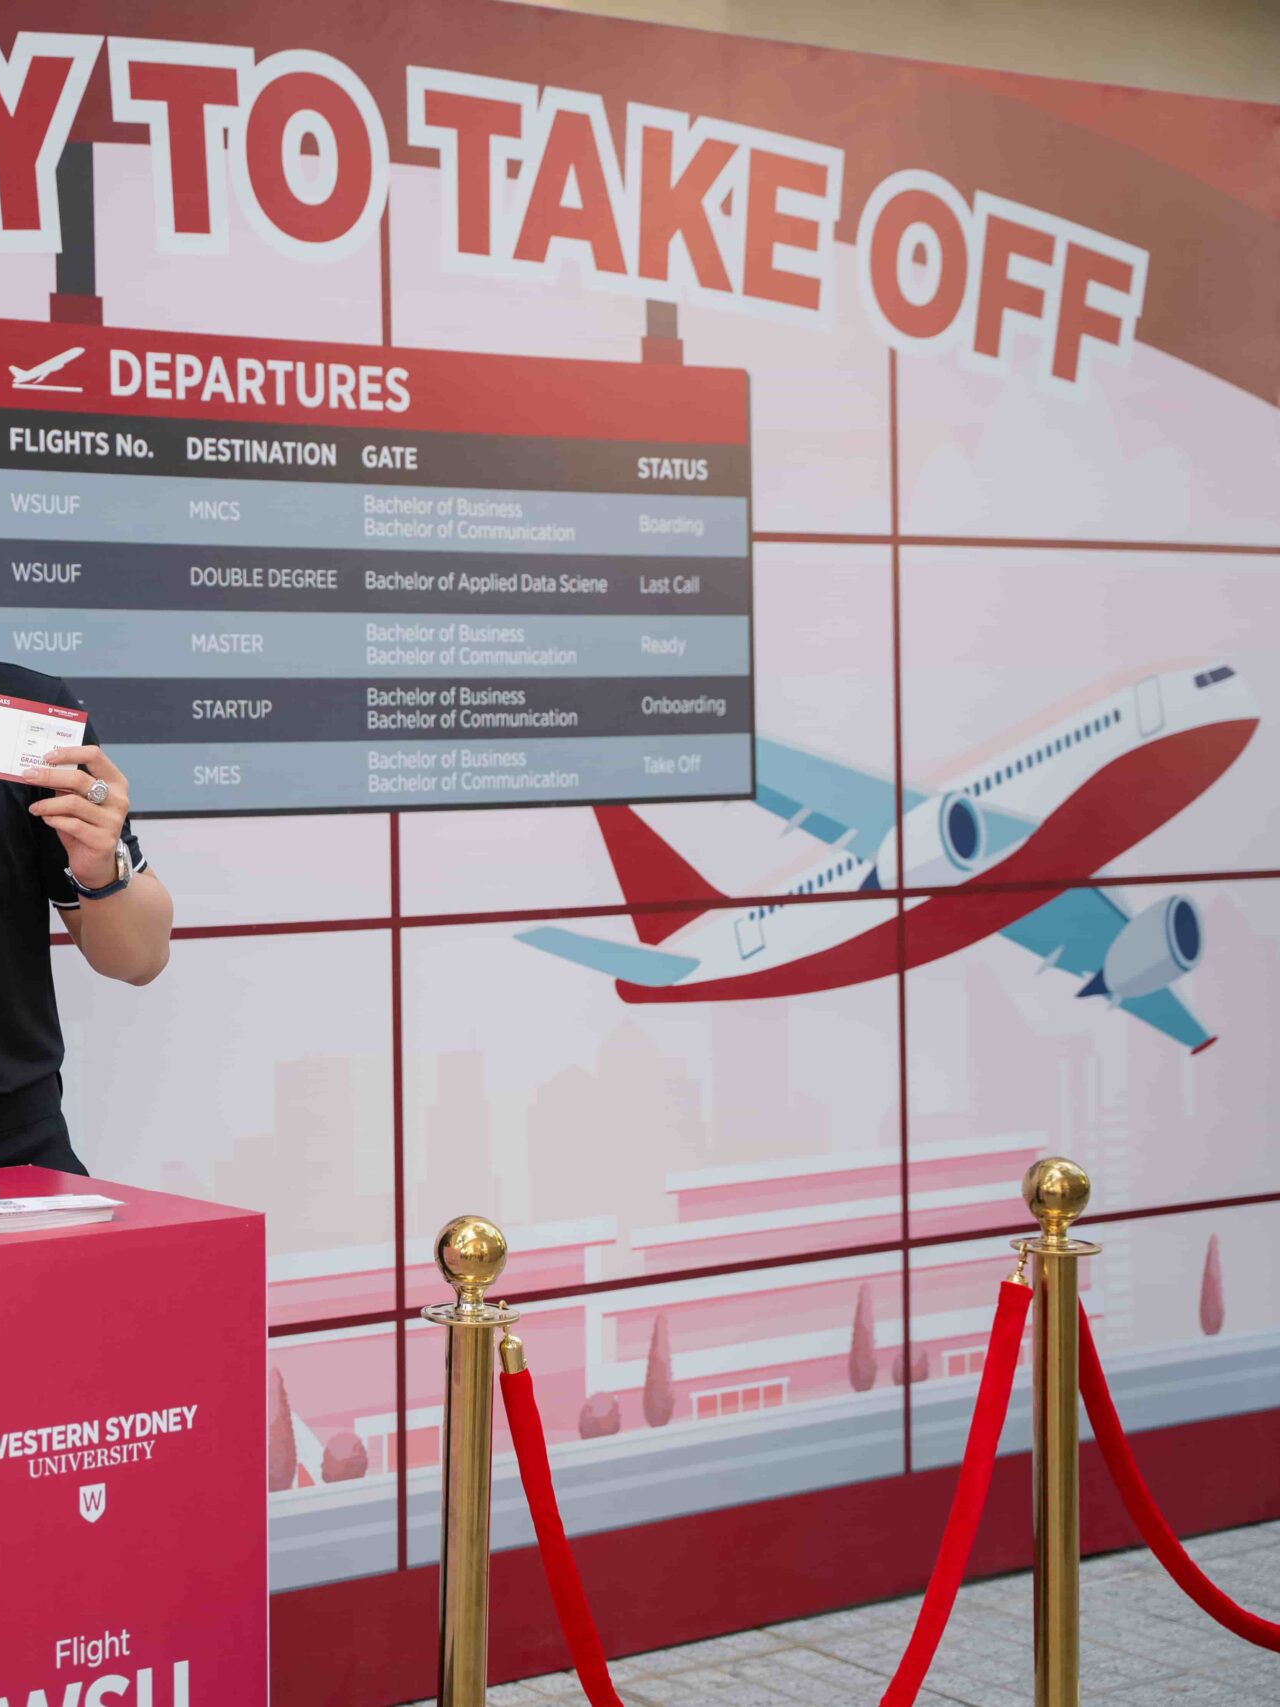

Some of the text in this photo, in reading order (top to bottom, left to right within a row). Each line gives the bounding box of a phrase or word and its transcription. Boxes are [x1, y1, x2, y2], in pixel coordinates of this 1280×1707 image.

[126, 58, 375, 244] TO
[422, 87, 831, 313] TAKE
[867, 187, 1136, 385] OFF
[109, 348, 411, 413] DEPARTURES
[9, 426, 155, 459] FLIGHTS No.
[186, 436, 338, 467] DESTINATION
[361, 445, 419, 470] GATE
[637, 456, 709, 481] STATUS
[10, 492, 81, 515] WSUUF
[189, 500, 241, 522] MNCS
[363, 494, 524, 519] Bachelor of Business
[363, 517, 576, 542] Bachelor of Communication
[638, 514, 705, 537] Boarding
[11, 561, 82, 584] WSUUF
[189, 566, 338, 590] DOUBLE DEGREE
[364, 570, 609, 596] Bachelor of Applied Data Sciene
[639, 575, 700, 594] Last Call
[13, 631, 83, 652] WSUUF
[191, 633, 264, 653] MASTER
[366, 622, 525, 643] Bachelor of Business
[366, 646, 578, 666] Bachelor of Communication
[640, 635, 687, 657] Ready
[366, 686, 526, 707] Bachelor of Business
[641, 695, 727, 717] Onboarding
[192, 699, 273, 720] STARTUP
[367, 707, 579, 730] Bachelor of Communication
[368, 750, 527, 771] Bachelor of Business
[642, 754, 702, 775] Take Off
[193, 765, 242, 786] SMES
[368, 771, 580, 793] Bachelor of Communication
[105, 1404, 198, 1443] SYDNEY
[28, 1439, 157, 1479] UNIVERSITY
[55, 1628, 131, 1669] Flight
